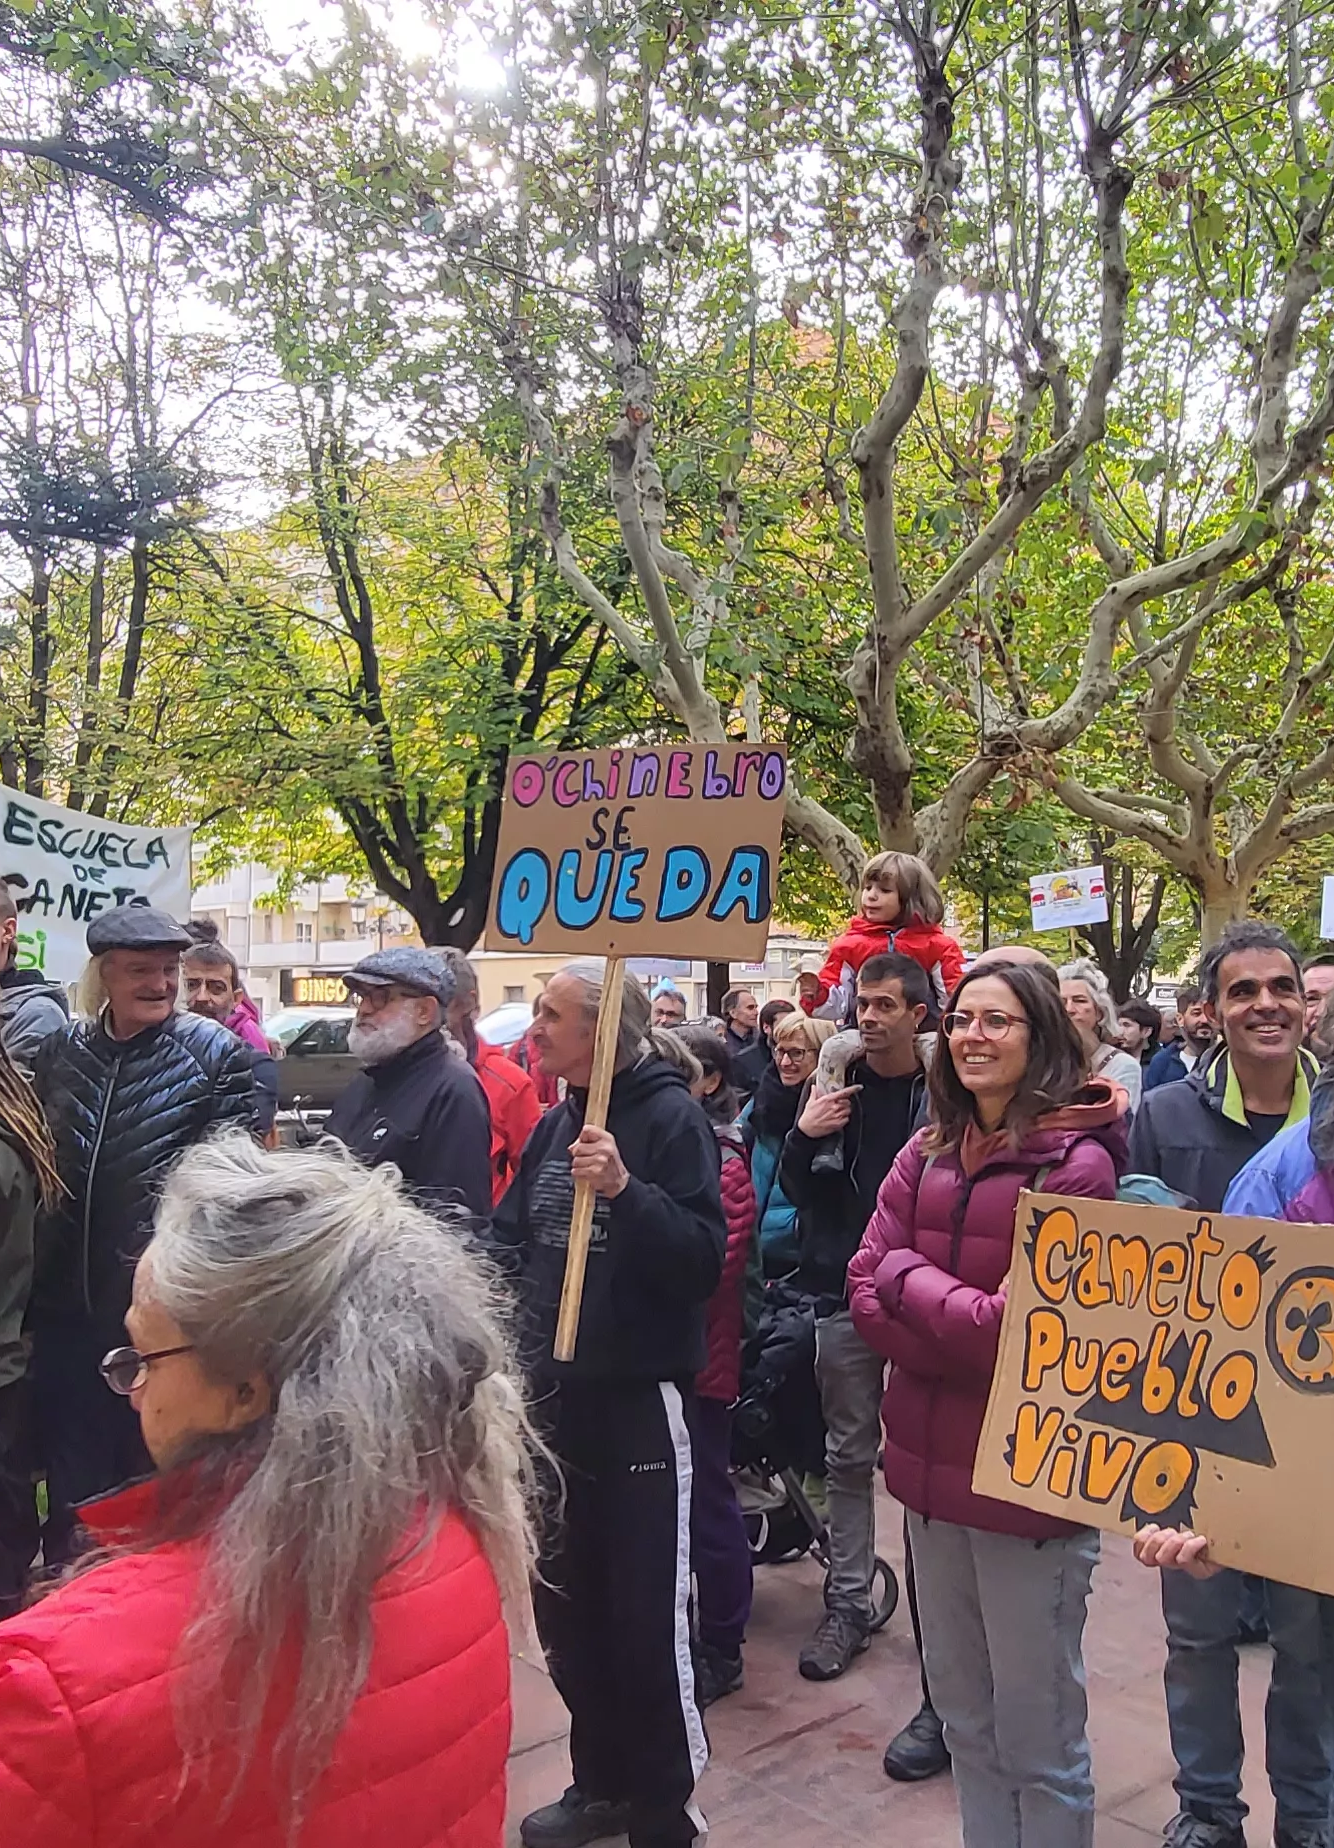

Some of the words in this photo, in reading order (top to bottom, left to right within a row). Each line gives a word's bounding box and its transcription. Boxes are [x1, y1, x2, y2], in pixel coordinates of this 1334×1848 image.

[3, 801, 170, 869] ESCUELA
[585, 806, 636, 851] SE
[72, 863, 107, 885] DE
[496, 845, 772, 945] QUEDA
[298, 978, 349, 1002] BINGO
[1025, 1206, 1263, 1331] Caneto
[1021, 1306, 1258, 1421] Pueblo
[1009, 1400, 1201, 1517] Vivo
